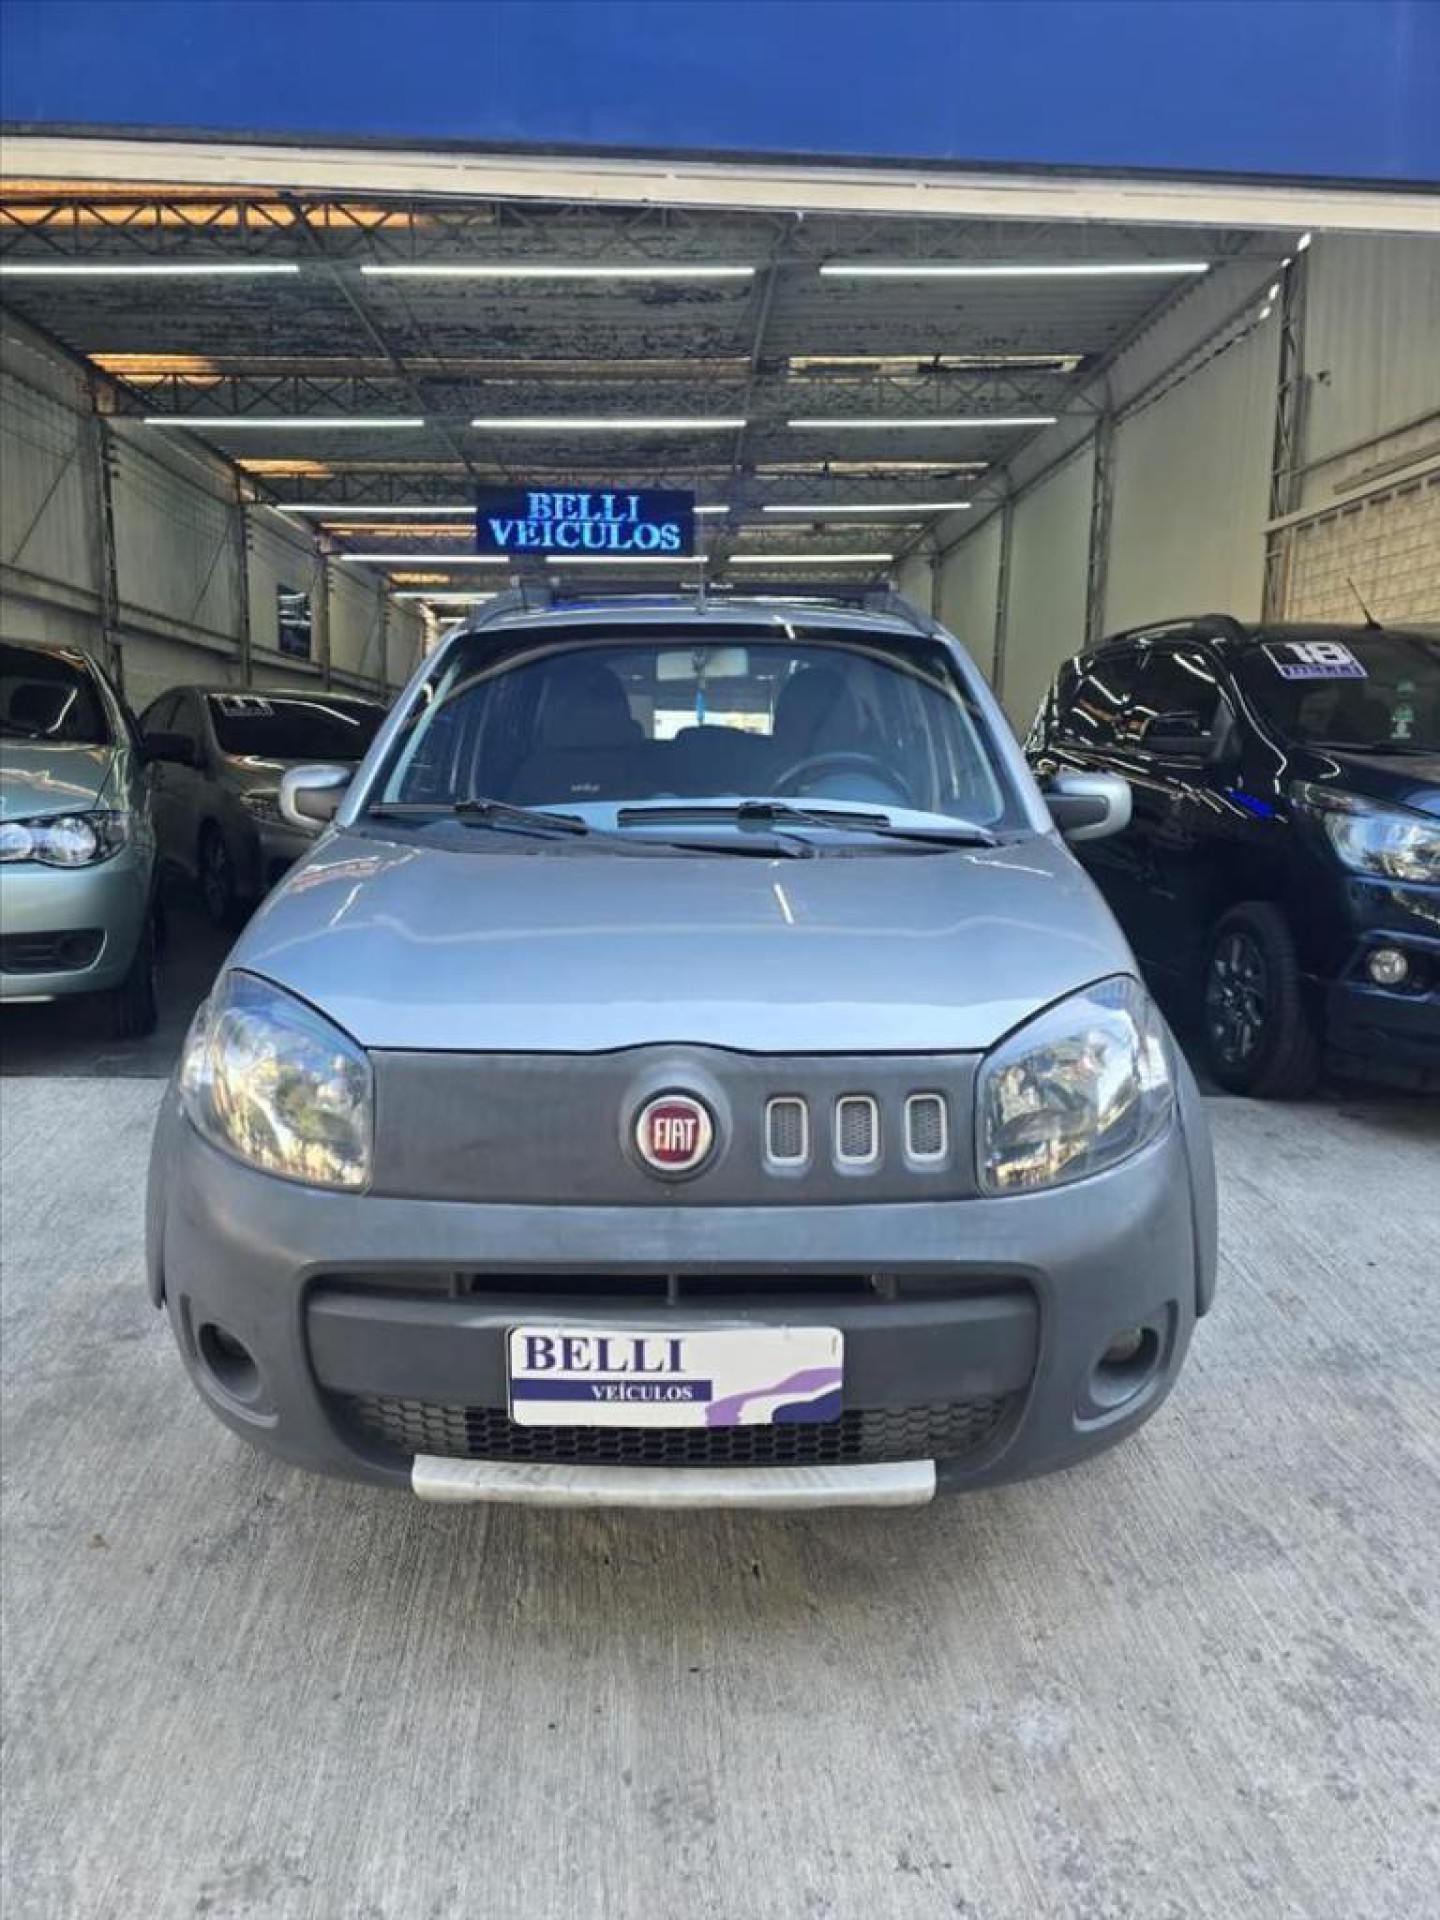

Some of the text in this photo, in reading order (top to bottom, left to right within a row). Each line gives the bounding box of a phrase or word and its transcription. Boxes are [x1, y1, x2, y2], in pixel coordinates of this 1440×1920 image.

[526, 492, 640, 522] BELLI
[488, 518, 681, 550] VEICULOS
[1285, 642, 1353, 664] 18
[654, 1117, 697, 1152] FIAT
[523, 1335, 687, 1373] BELLI
[591, 1380, 693, 1401] VEÍCULOS
